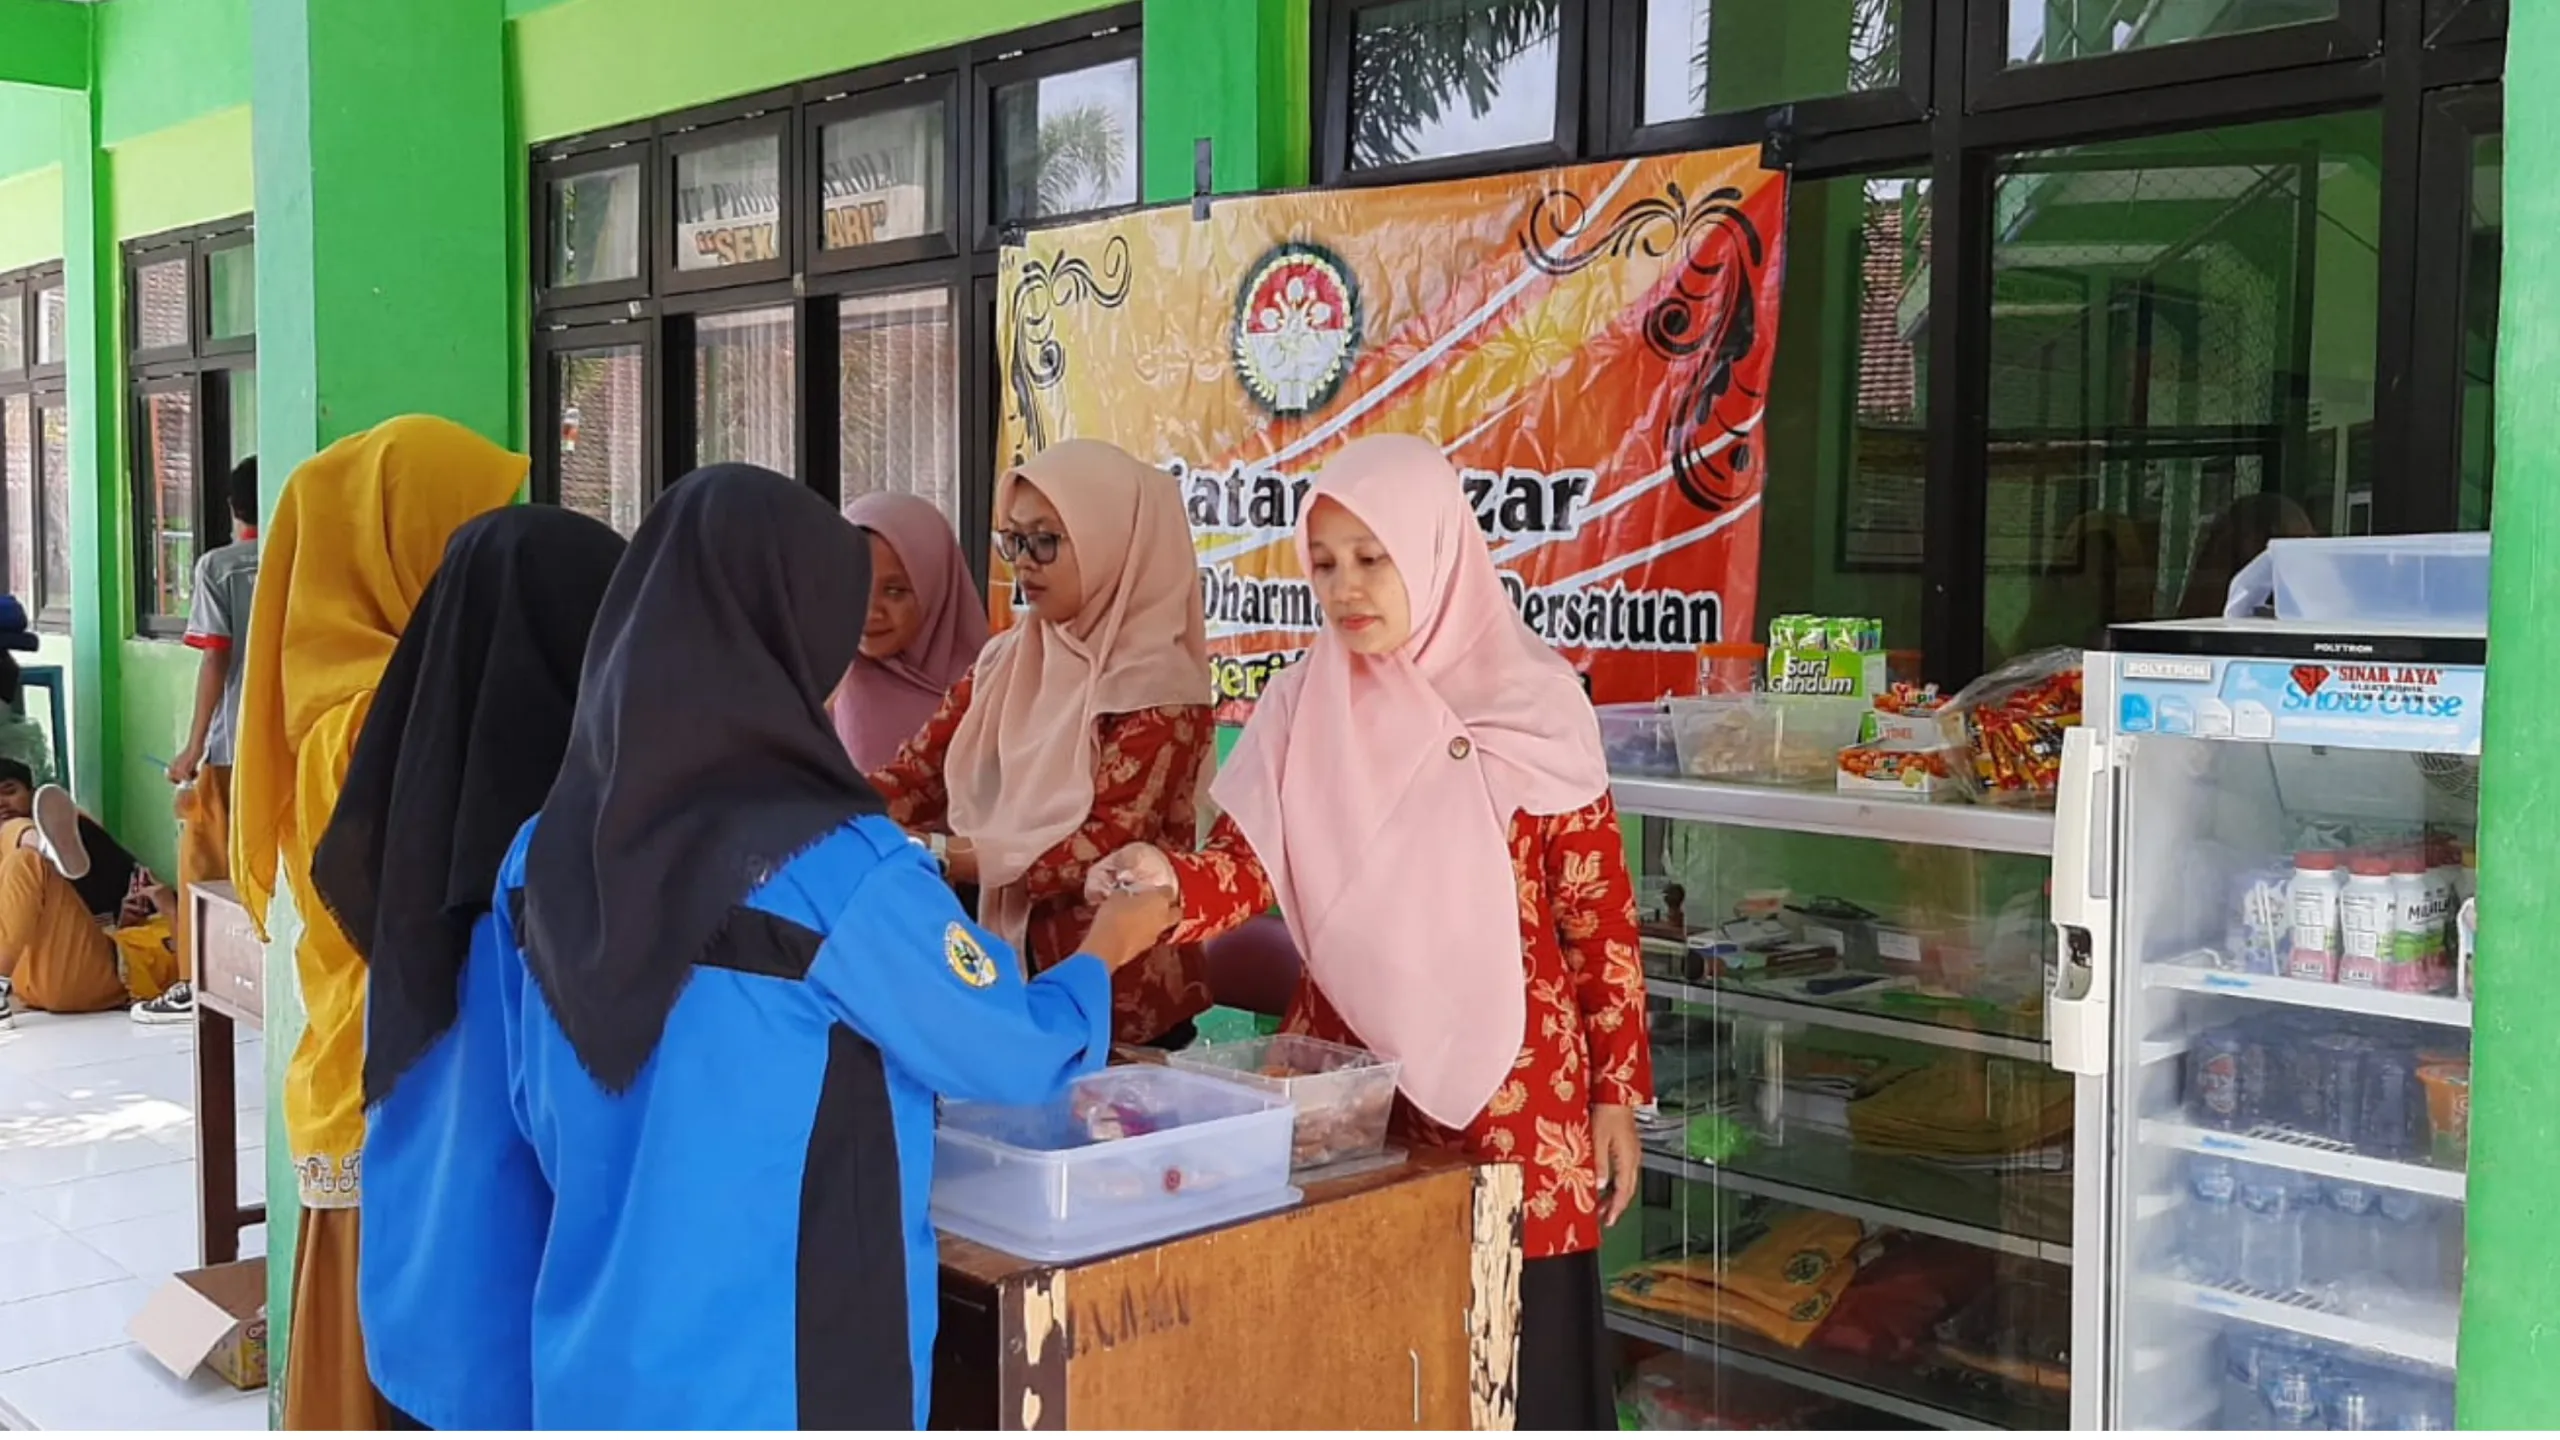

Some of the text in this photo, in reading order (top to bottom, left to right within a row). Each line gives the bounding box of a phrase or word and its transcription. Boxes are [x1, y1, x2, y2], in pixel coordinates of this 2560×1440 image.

[1463, 476, 1589, 533] zar
[1787, 656, 1829, 678] Sari
[1769, 676, 1854, 695] Gandum
